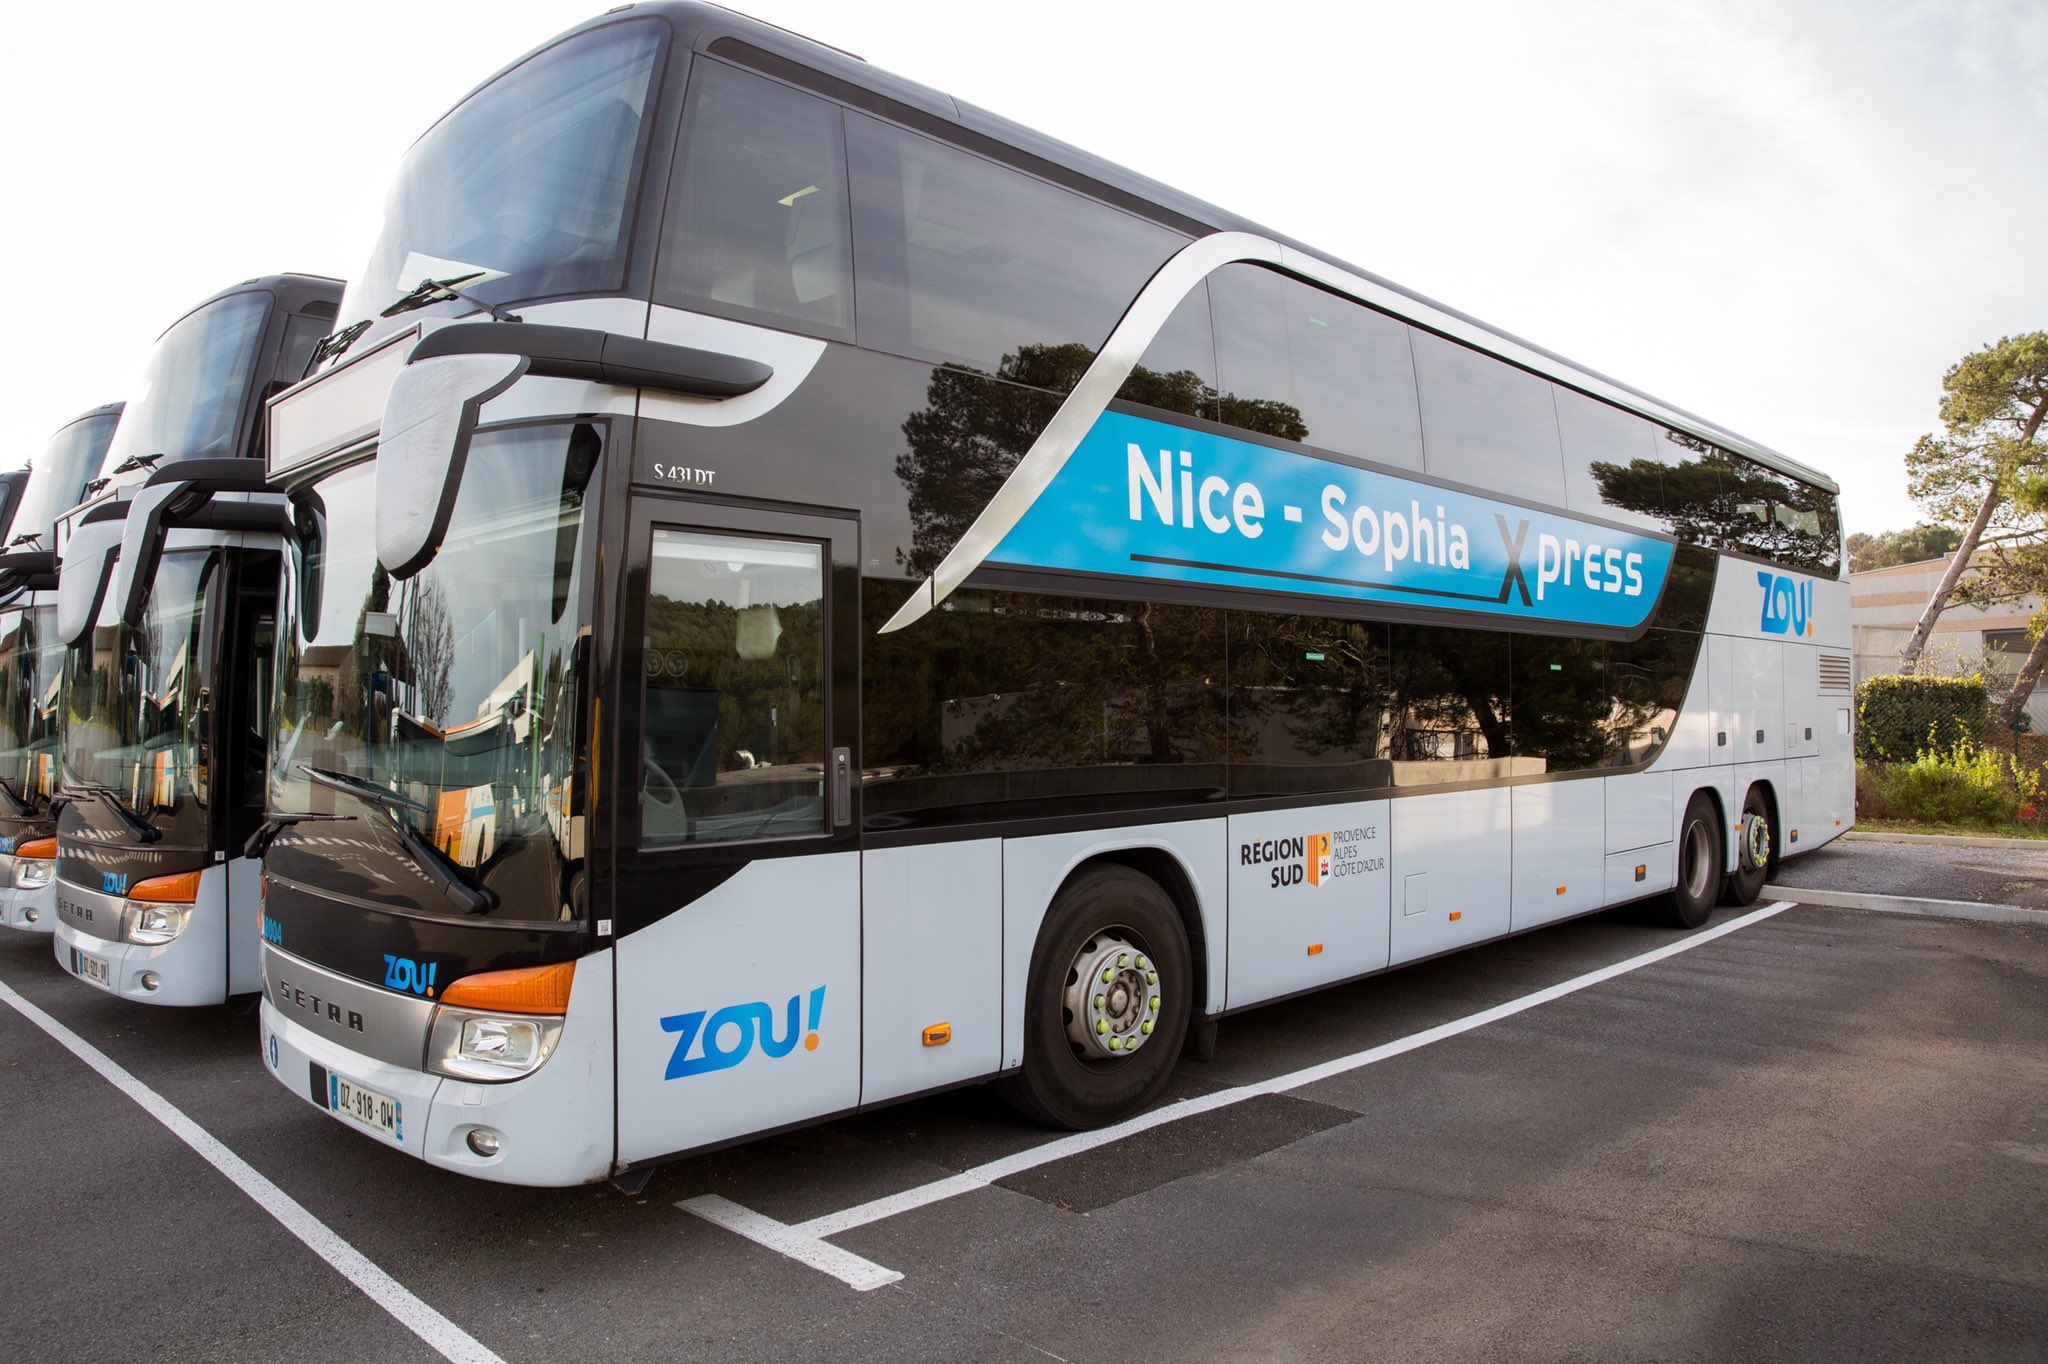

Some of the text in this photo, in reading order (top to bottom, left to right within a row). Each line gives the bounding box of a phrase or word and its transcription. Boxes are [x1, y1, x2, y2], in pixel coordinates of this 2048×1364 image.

[653, 463, 716, 487] S 431 DT
[1127, 443, 1643, 606] Nice - Sophia Xpress
[1757, 571, 1813, 638] ZOU!
[1333, 826, 1376, 844] PROVENCE
[1241, 837, 1304, 866] RÉGION
[1333, 845, 1358, 861] ALPES
[1271, 863, 1304, 889] SUD
[1333, 857, 1385, 878] CÔTE D'AZUR
[102, 871, 128, 895] ZOU!
[57, 897, 93, 921] SETRA
[384, 953, 437, 997] ZOU!
[280, 979, 364, 1034] SETRA
[659, 984, 827, 1082] ZOU!
